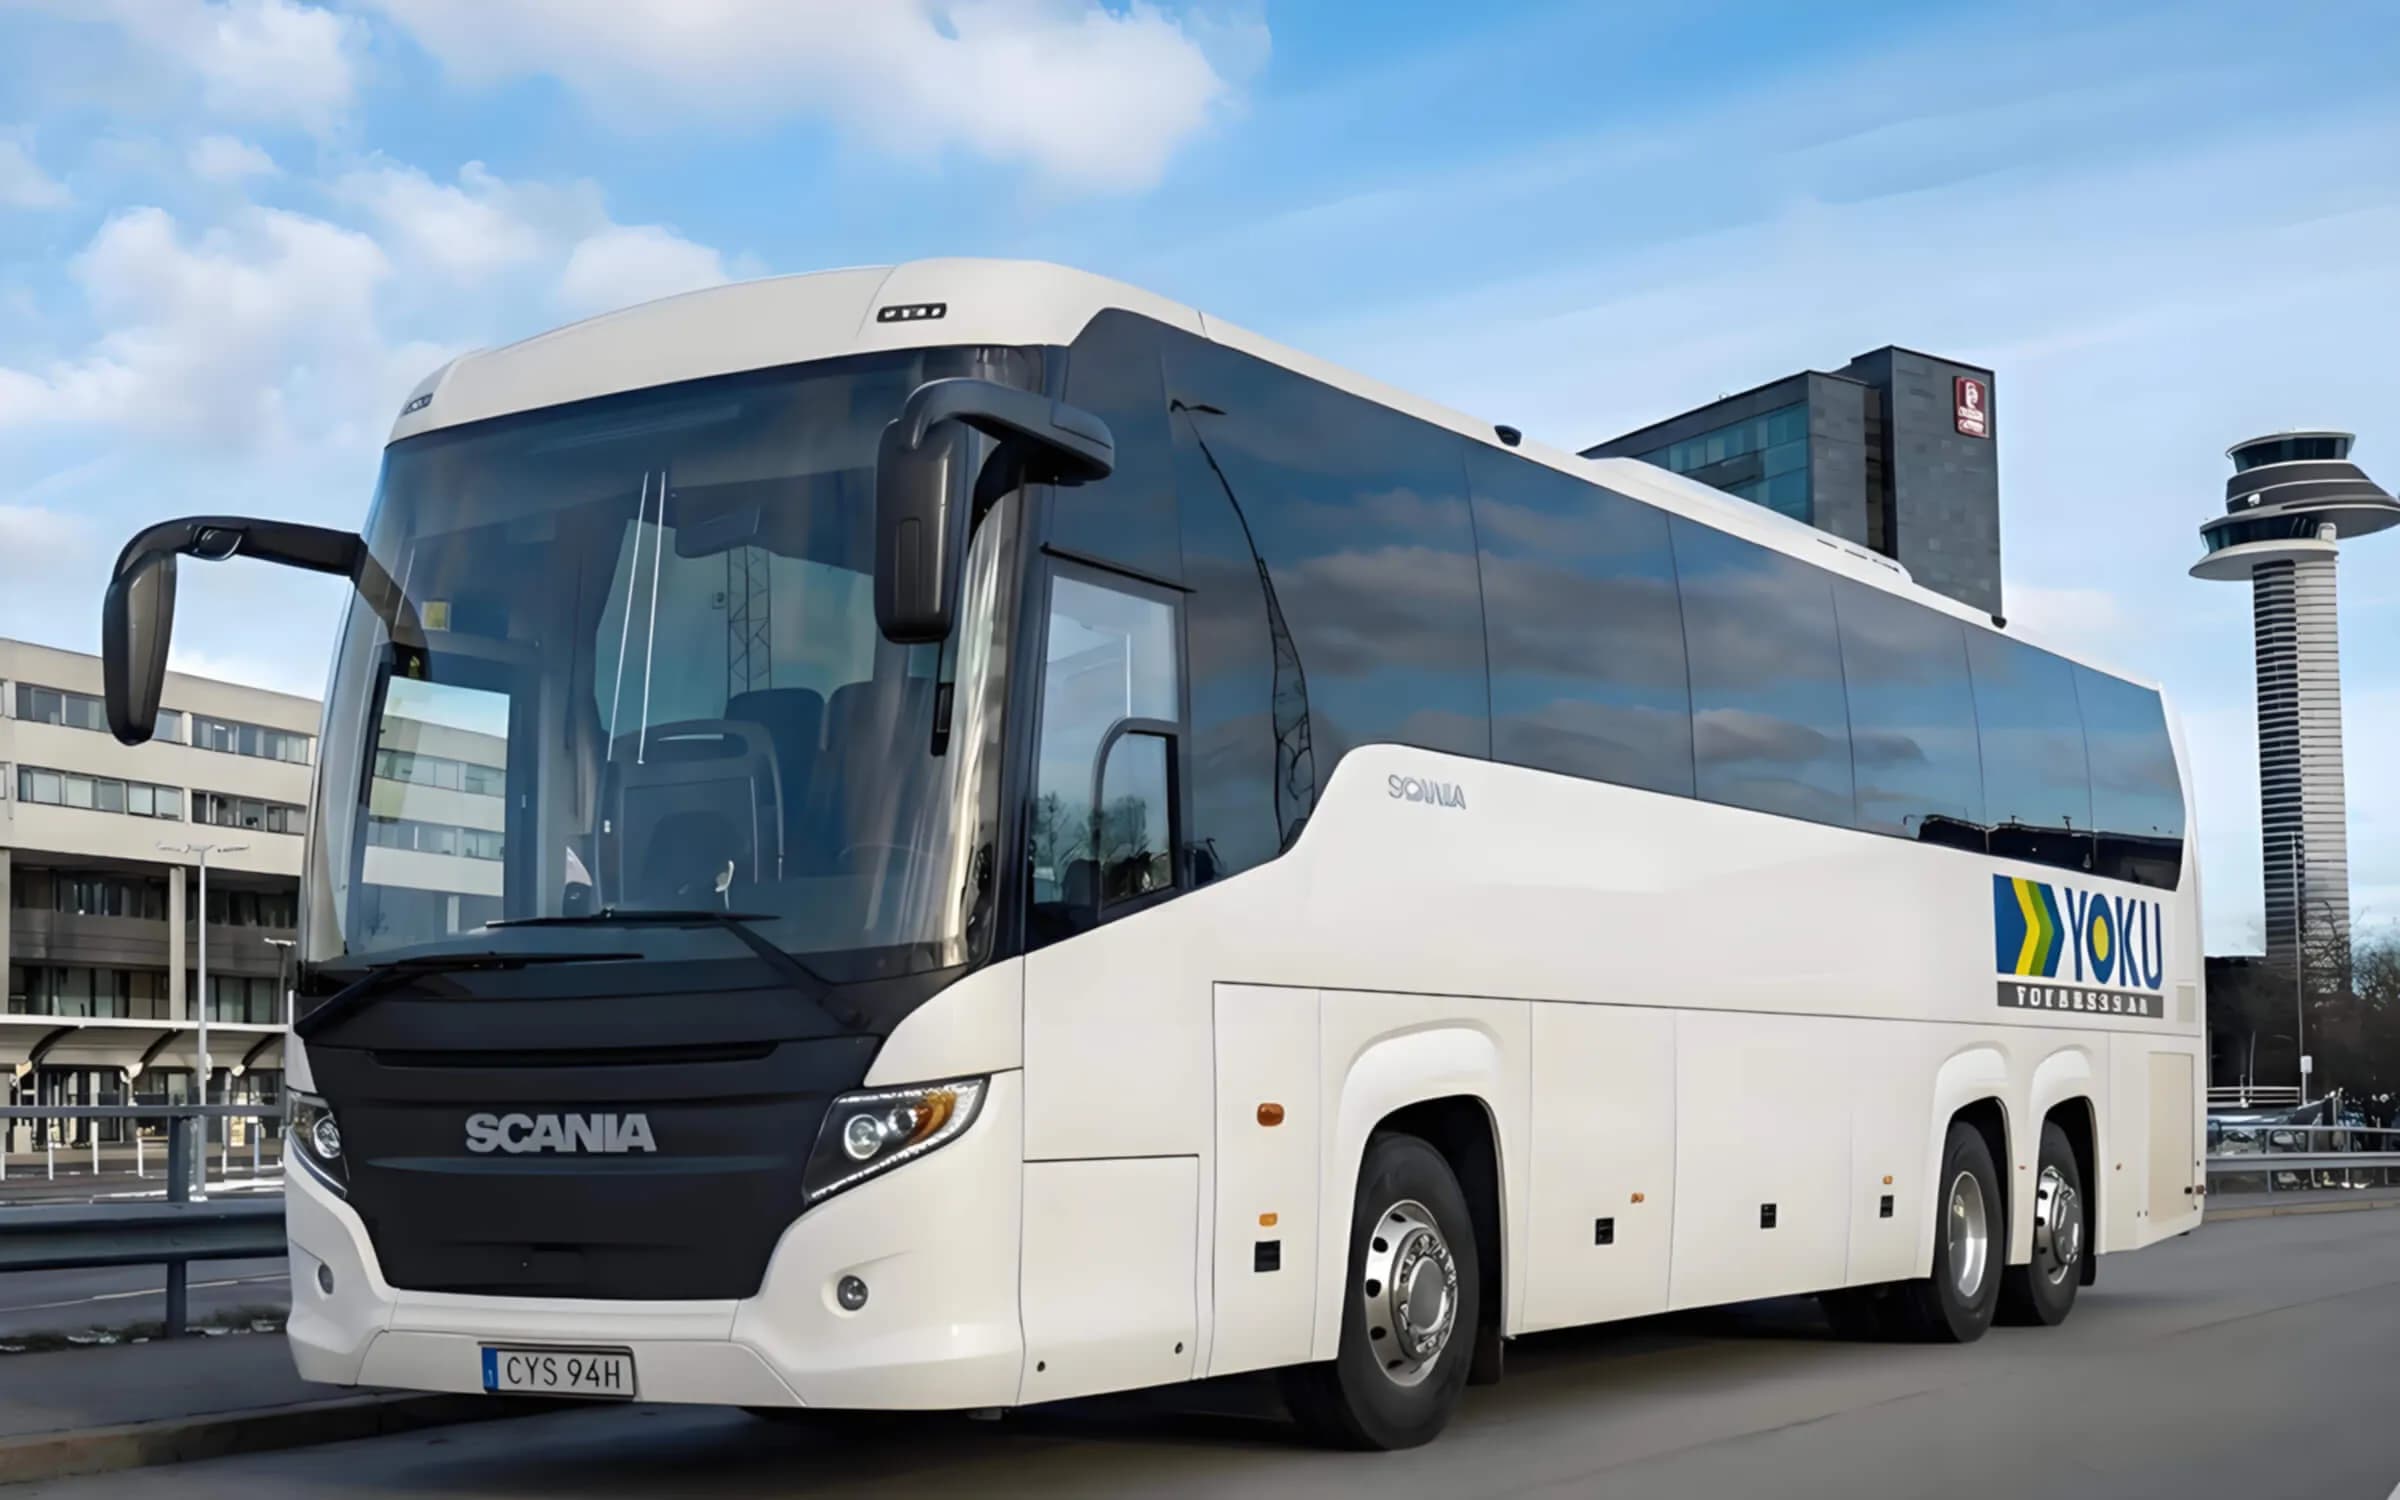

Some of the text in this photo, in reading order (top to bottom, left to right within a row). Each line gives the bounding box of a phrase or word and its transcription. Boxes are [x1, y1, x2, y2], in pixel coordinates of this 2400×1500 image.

[2064, 887, 2162, 990] YOKU
[465, 1113, 657, 1153] SCANIA
[507, 1356, 621, 1389] CYS 94H
